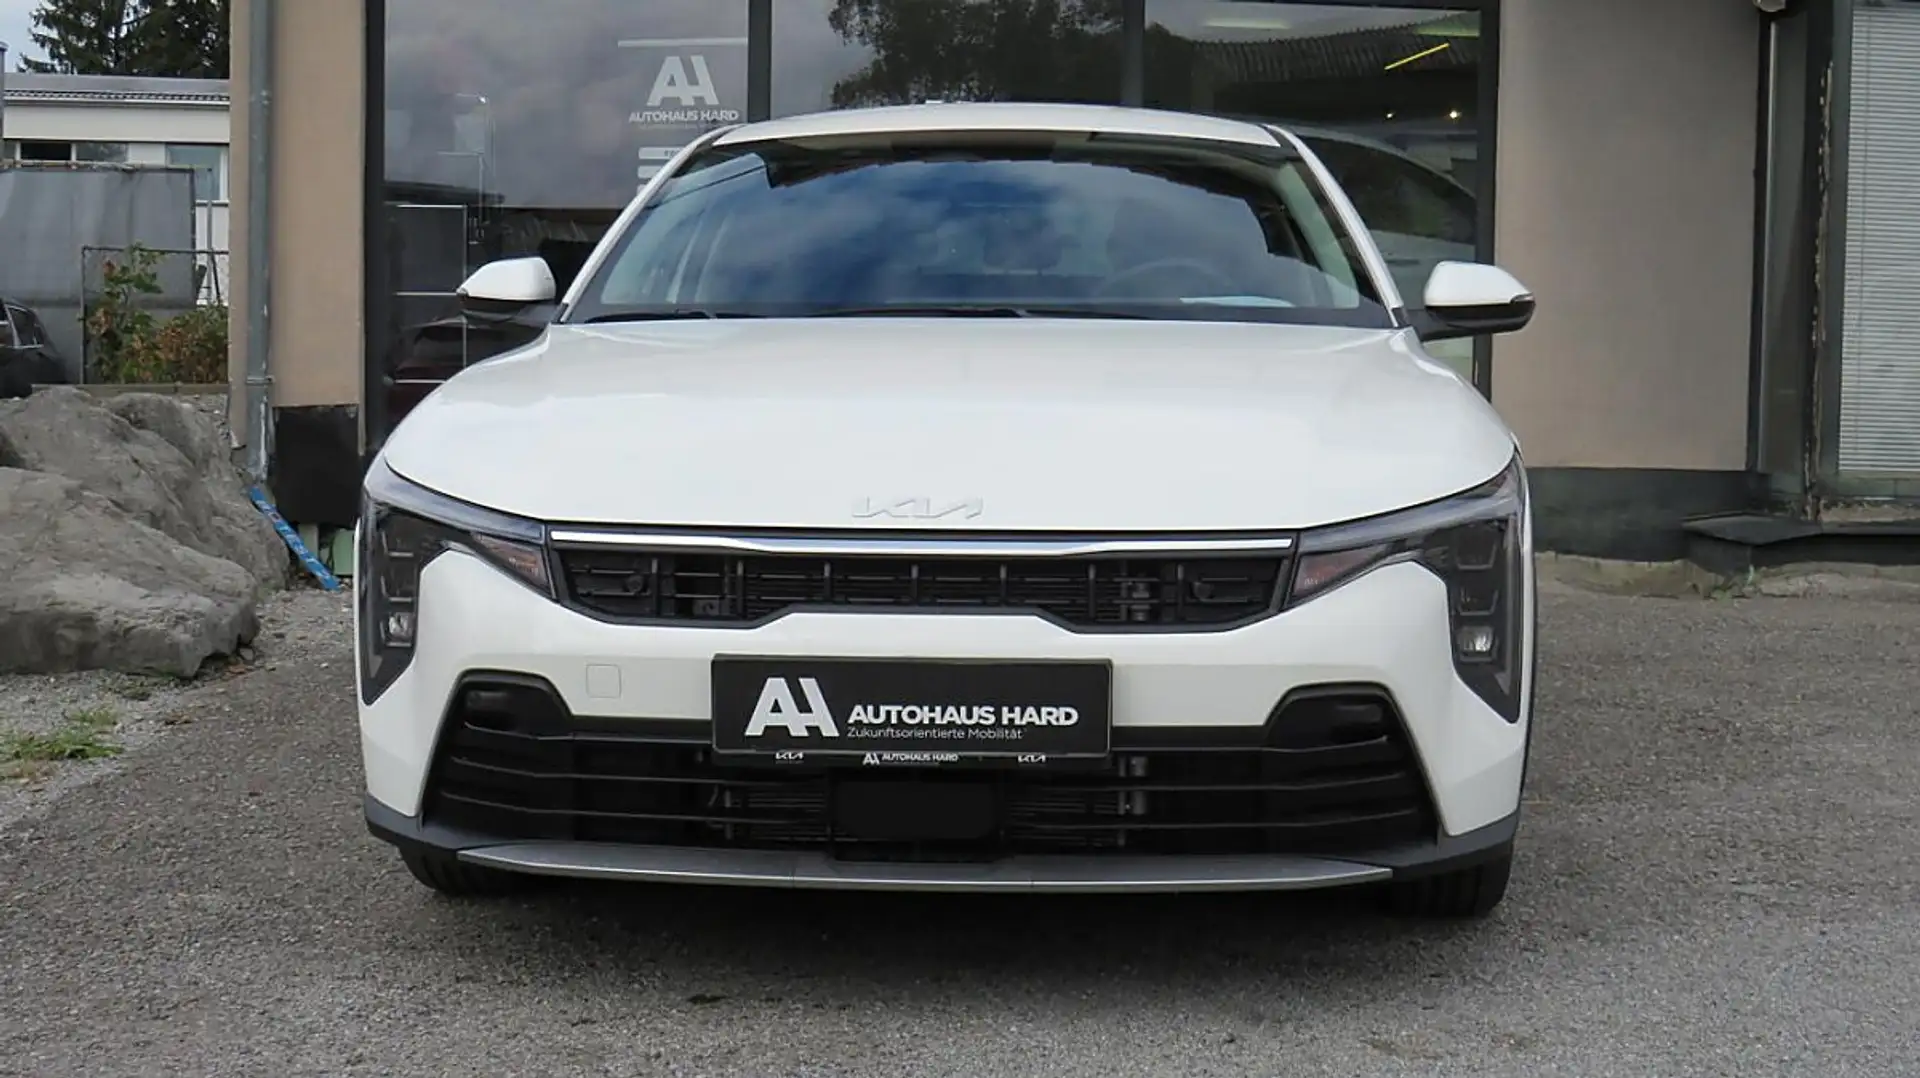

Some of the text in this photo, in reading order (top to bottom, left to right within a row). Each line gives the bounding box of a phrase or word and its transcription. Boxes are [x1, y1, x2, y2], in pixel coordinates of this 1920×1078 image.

[629, 110, 739, 122] AUTOHAUS HARD
[852, 496, 983, 520] KIA
[848, 705, 1079, 726] AUTOHAUS HARD
[847, 726, 1024, 740] Zukunftsorientierte Mobilität
[882, 752, 931, 762] AUTOHAUS
[932, 753, 958, 763] HARD
